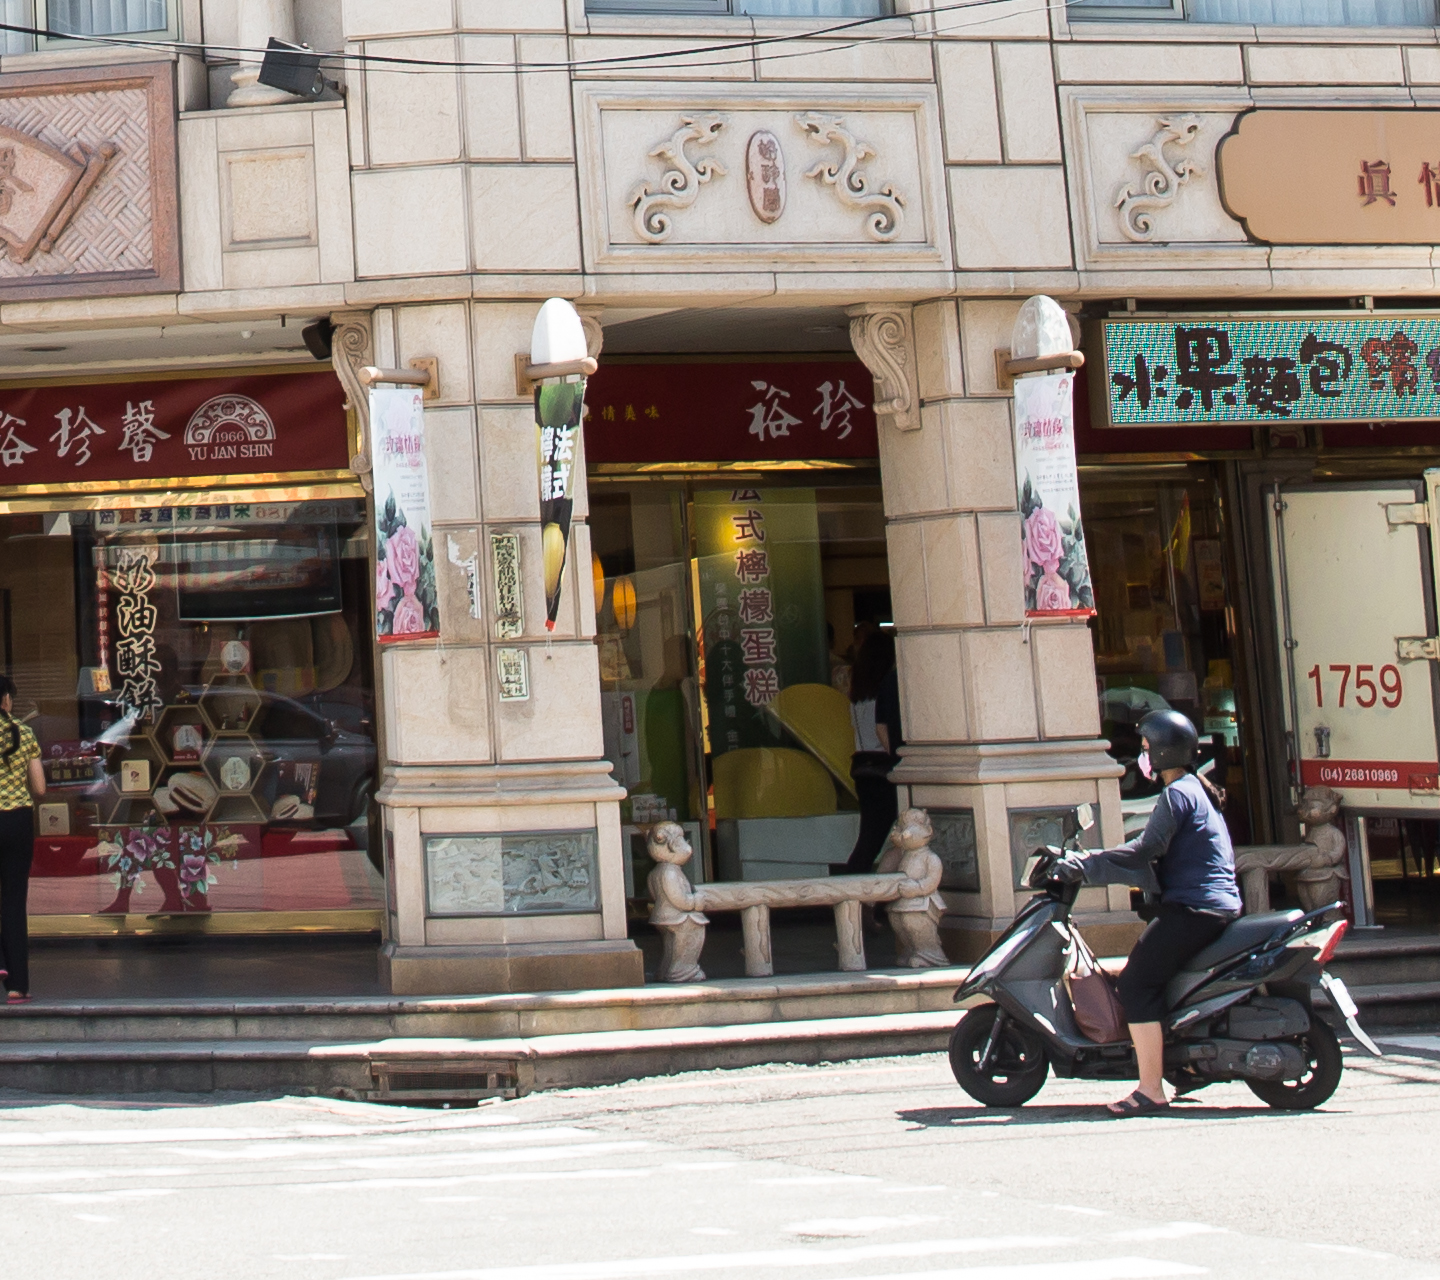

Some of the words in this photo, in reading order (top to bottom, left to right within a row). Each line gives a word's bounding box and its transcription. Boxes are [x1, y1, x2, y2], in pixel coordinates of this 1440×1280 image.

[582, 402, 661, 423] 情美味
[744, 378, 865, 442] 裕珍
[187, 446, 208, 461] YU
[209, 444, 238, 460] JAN
[239, 443, 273, 459] SHIN
[214, 430, 246, 443] 1966
[113, 552, 163, 725] 奶油酥餅
[1307, 663, 1403, 709] 1759
